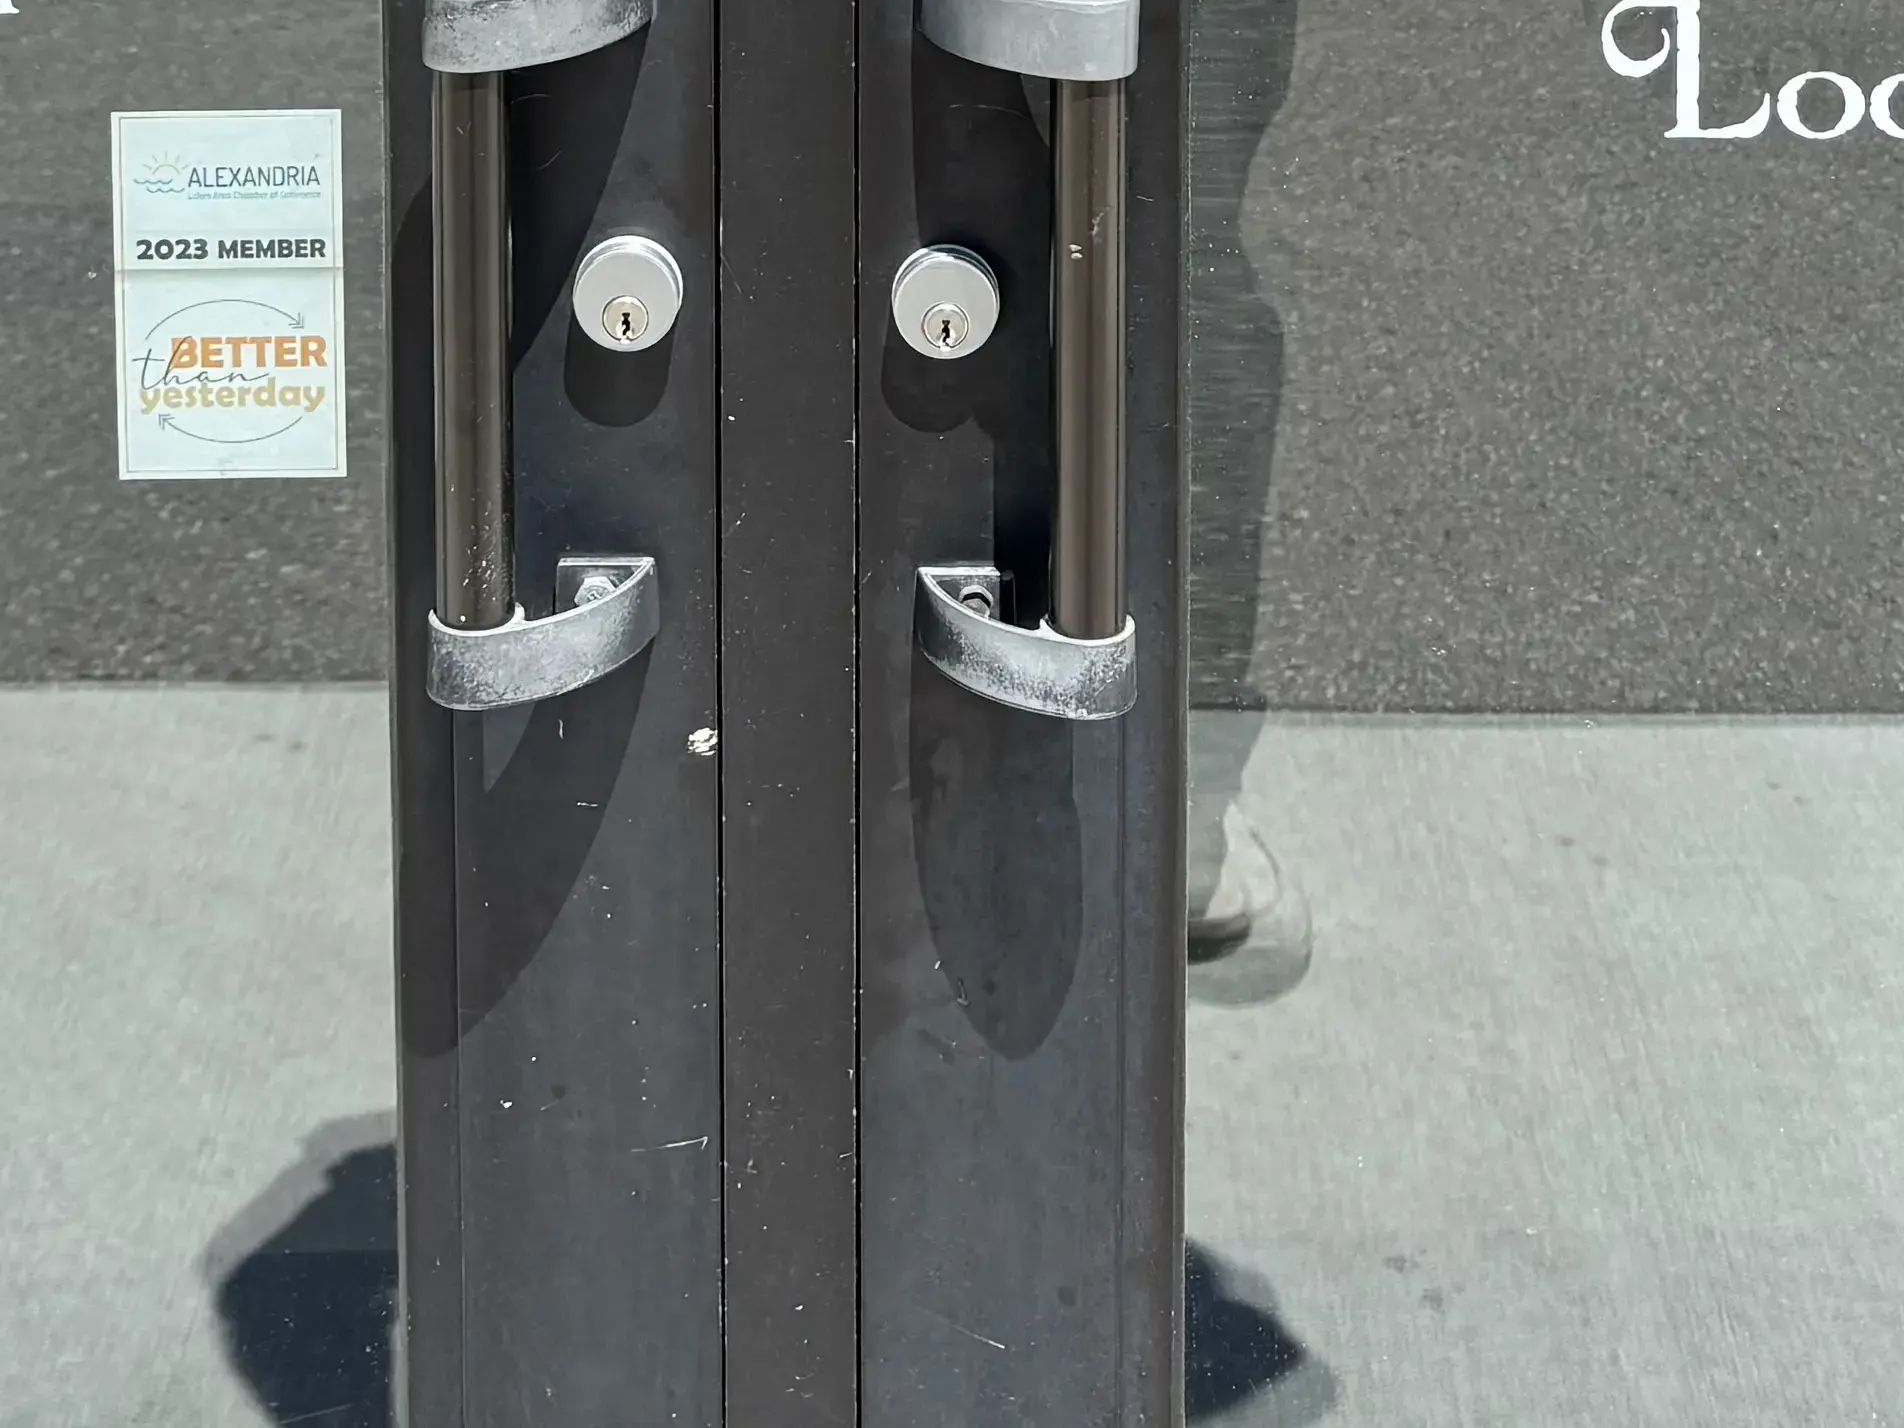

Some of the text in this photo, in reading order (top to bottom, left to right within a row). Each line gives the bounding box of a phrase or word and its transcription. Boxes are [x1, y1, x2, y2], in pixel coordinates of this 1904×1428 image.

[187, 165, 321, 188] ALEXANDRIA
[136, 237, 327, 261] 2023 MEMBER
[132, 335, 270, 390] than
[171, 335, 328, 369] BETTER
[139, 377, 326, 416] yesterday
